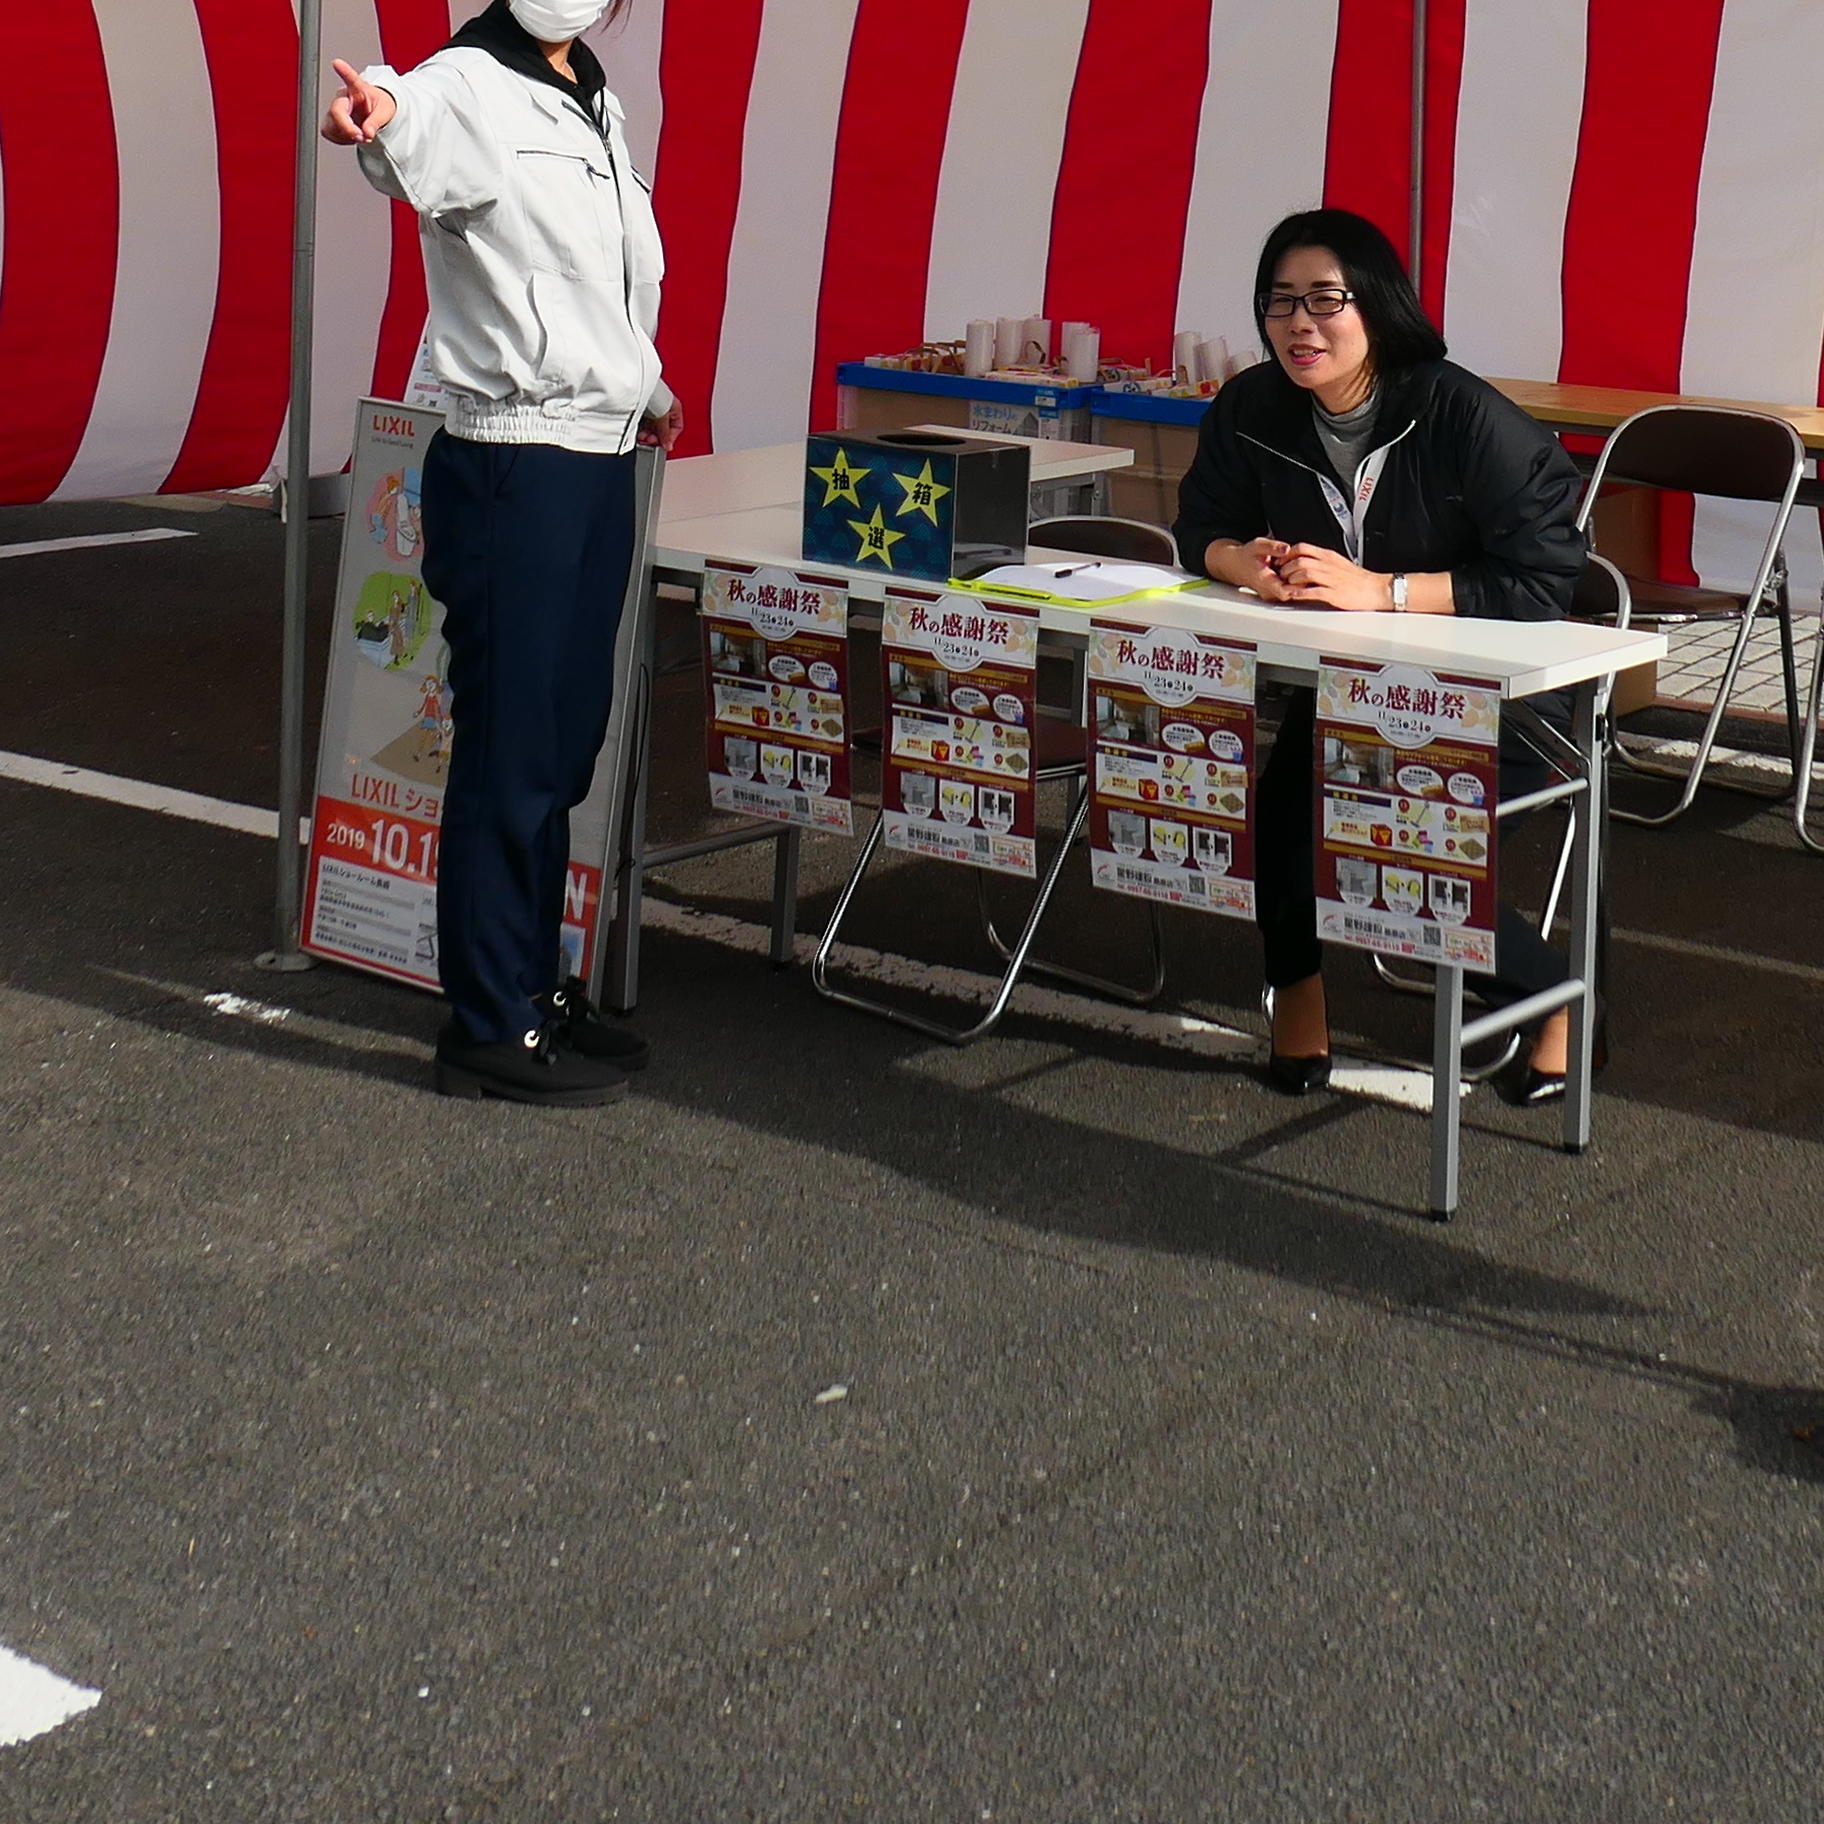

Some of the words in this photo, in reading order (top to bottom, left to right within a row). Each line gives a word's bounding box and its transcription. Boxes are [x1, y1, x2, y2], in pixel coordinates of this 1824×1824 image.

[372, 415, 416, 437] LIXIL
[912, 482, 933, 506] 箱
[727, 579, 821, 615] 秋の感謝祭
[909, 607, 1009, 645] 秋の感謝祭
[1117, 640, 1225, 680] 秋の感謝祭
[1348, 678, 1466, 719] 秋の感謝祭
[326, 823, 365, 850] 2019
